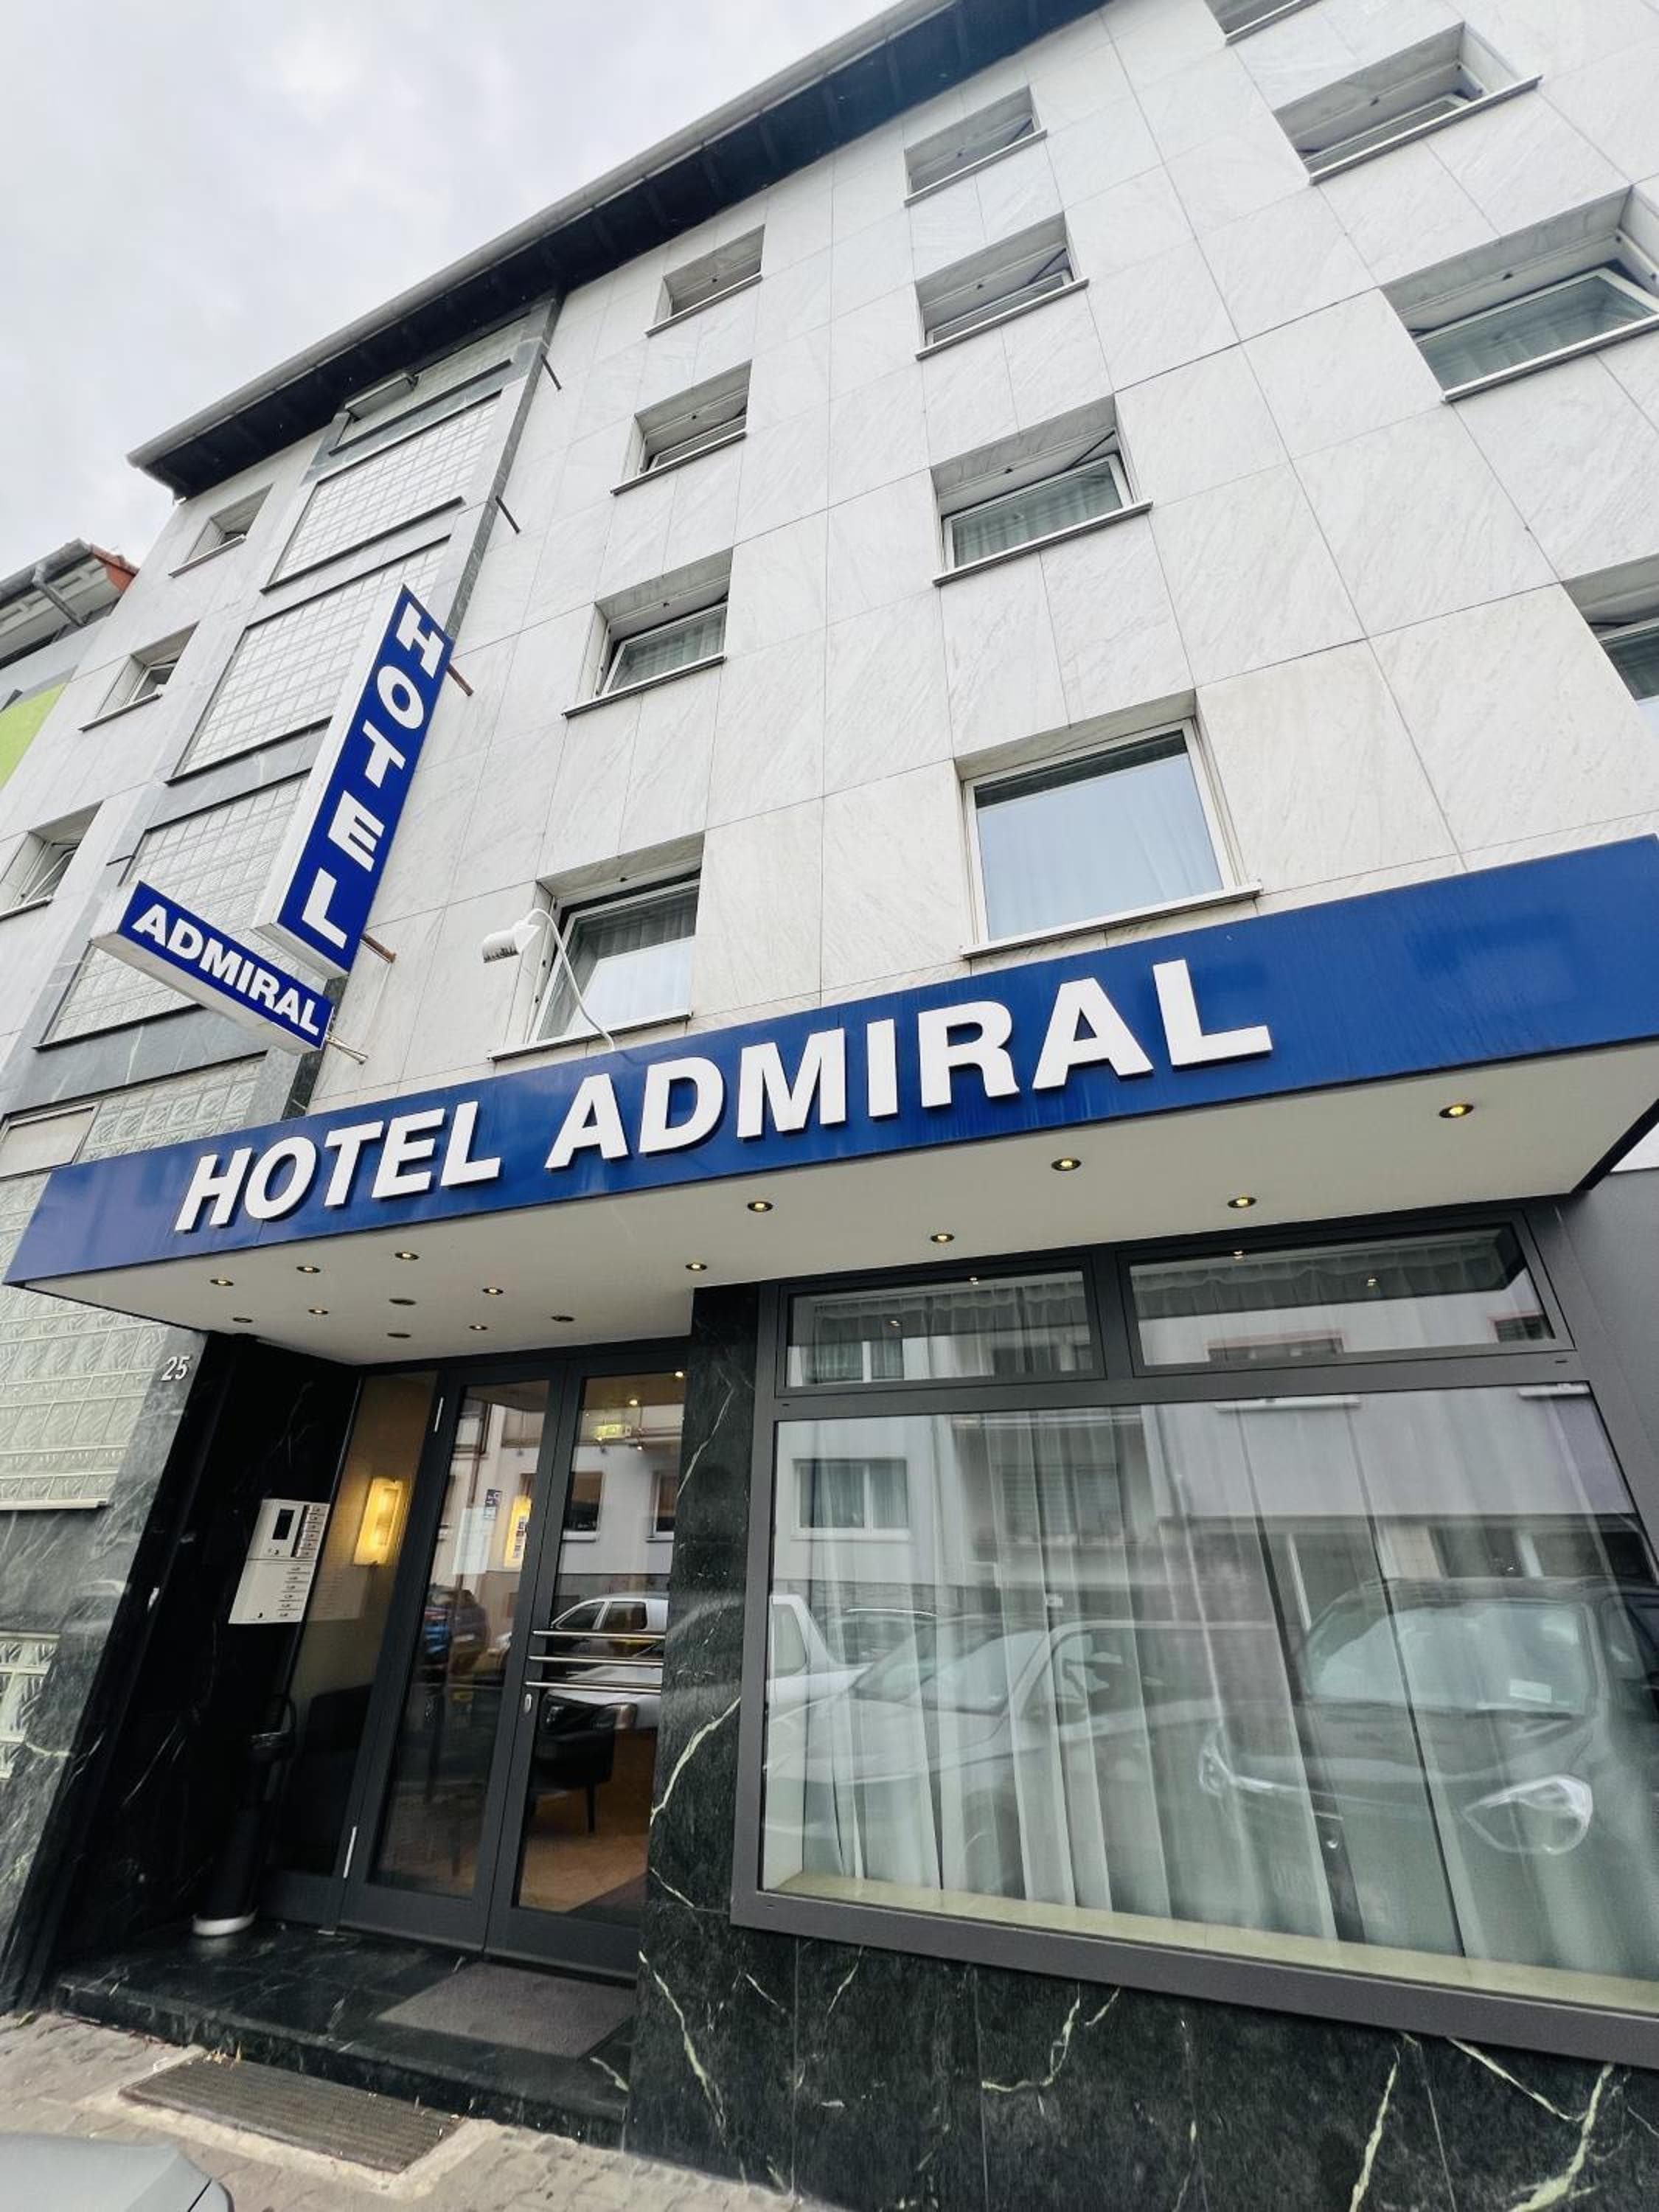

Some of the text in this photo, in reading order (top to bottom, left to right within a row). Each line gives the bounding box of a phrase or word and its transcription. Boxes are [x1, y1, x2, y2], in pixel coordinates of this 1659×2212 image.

[302, 602, 445, 949] HOTEL
[133, 903, 319, 1036] ADMIRAL
[174, 959, 1274, 1233] HOTEL ADMIRAL
[161, 1356, 190, 1380] 25
